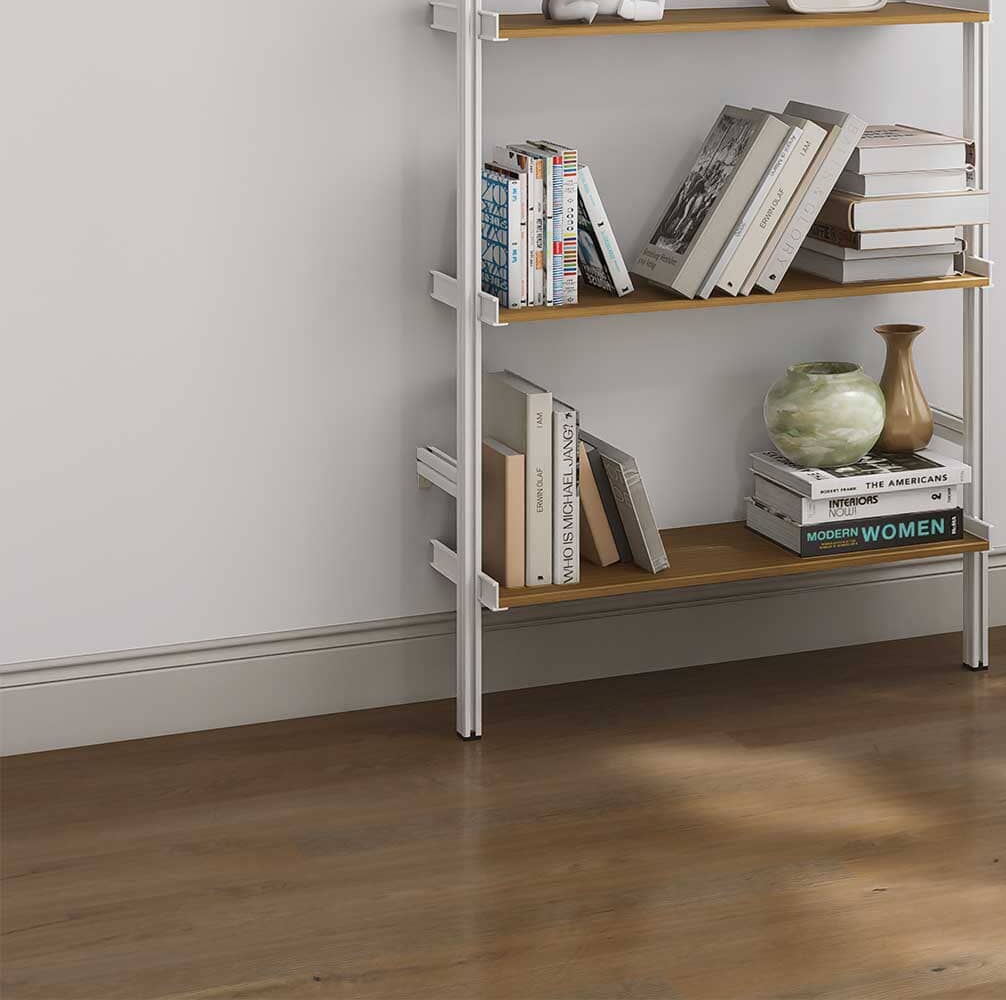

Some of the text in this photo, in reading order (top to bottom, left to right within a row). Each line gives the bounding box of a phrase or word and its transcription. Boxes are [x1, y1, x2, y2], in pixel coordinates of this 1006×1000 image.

[759, 205, 776, 229] ERWIN
[770, 187, 786, 208] OLAF
[775, 201, 817, 267] GLORY
[537, 412, 543, 425] AM
[865, 474, 948, 489] THE AMERICANS
[563, 423, 574, 584] WHO IS MICHAEL JANG?
[829, 494, 879, 508] INTERIORS
[829, 506, 857, 518] NOW!
[807, 518, 945, 543] MODERN WOMEN
